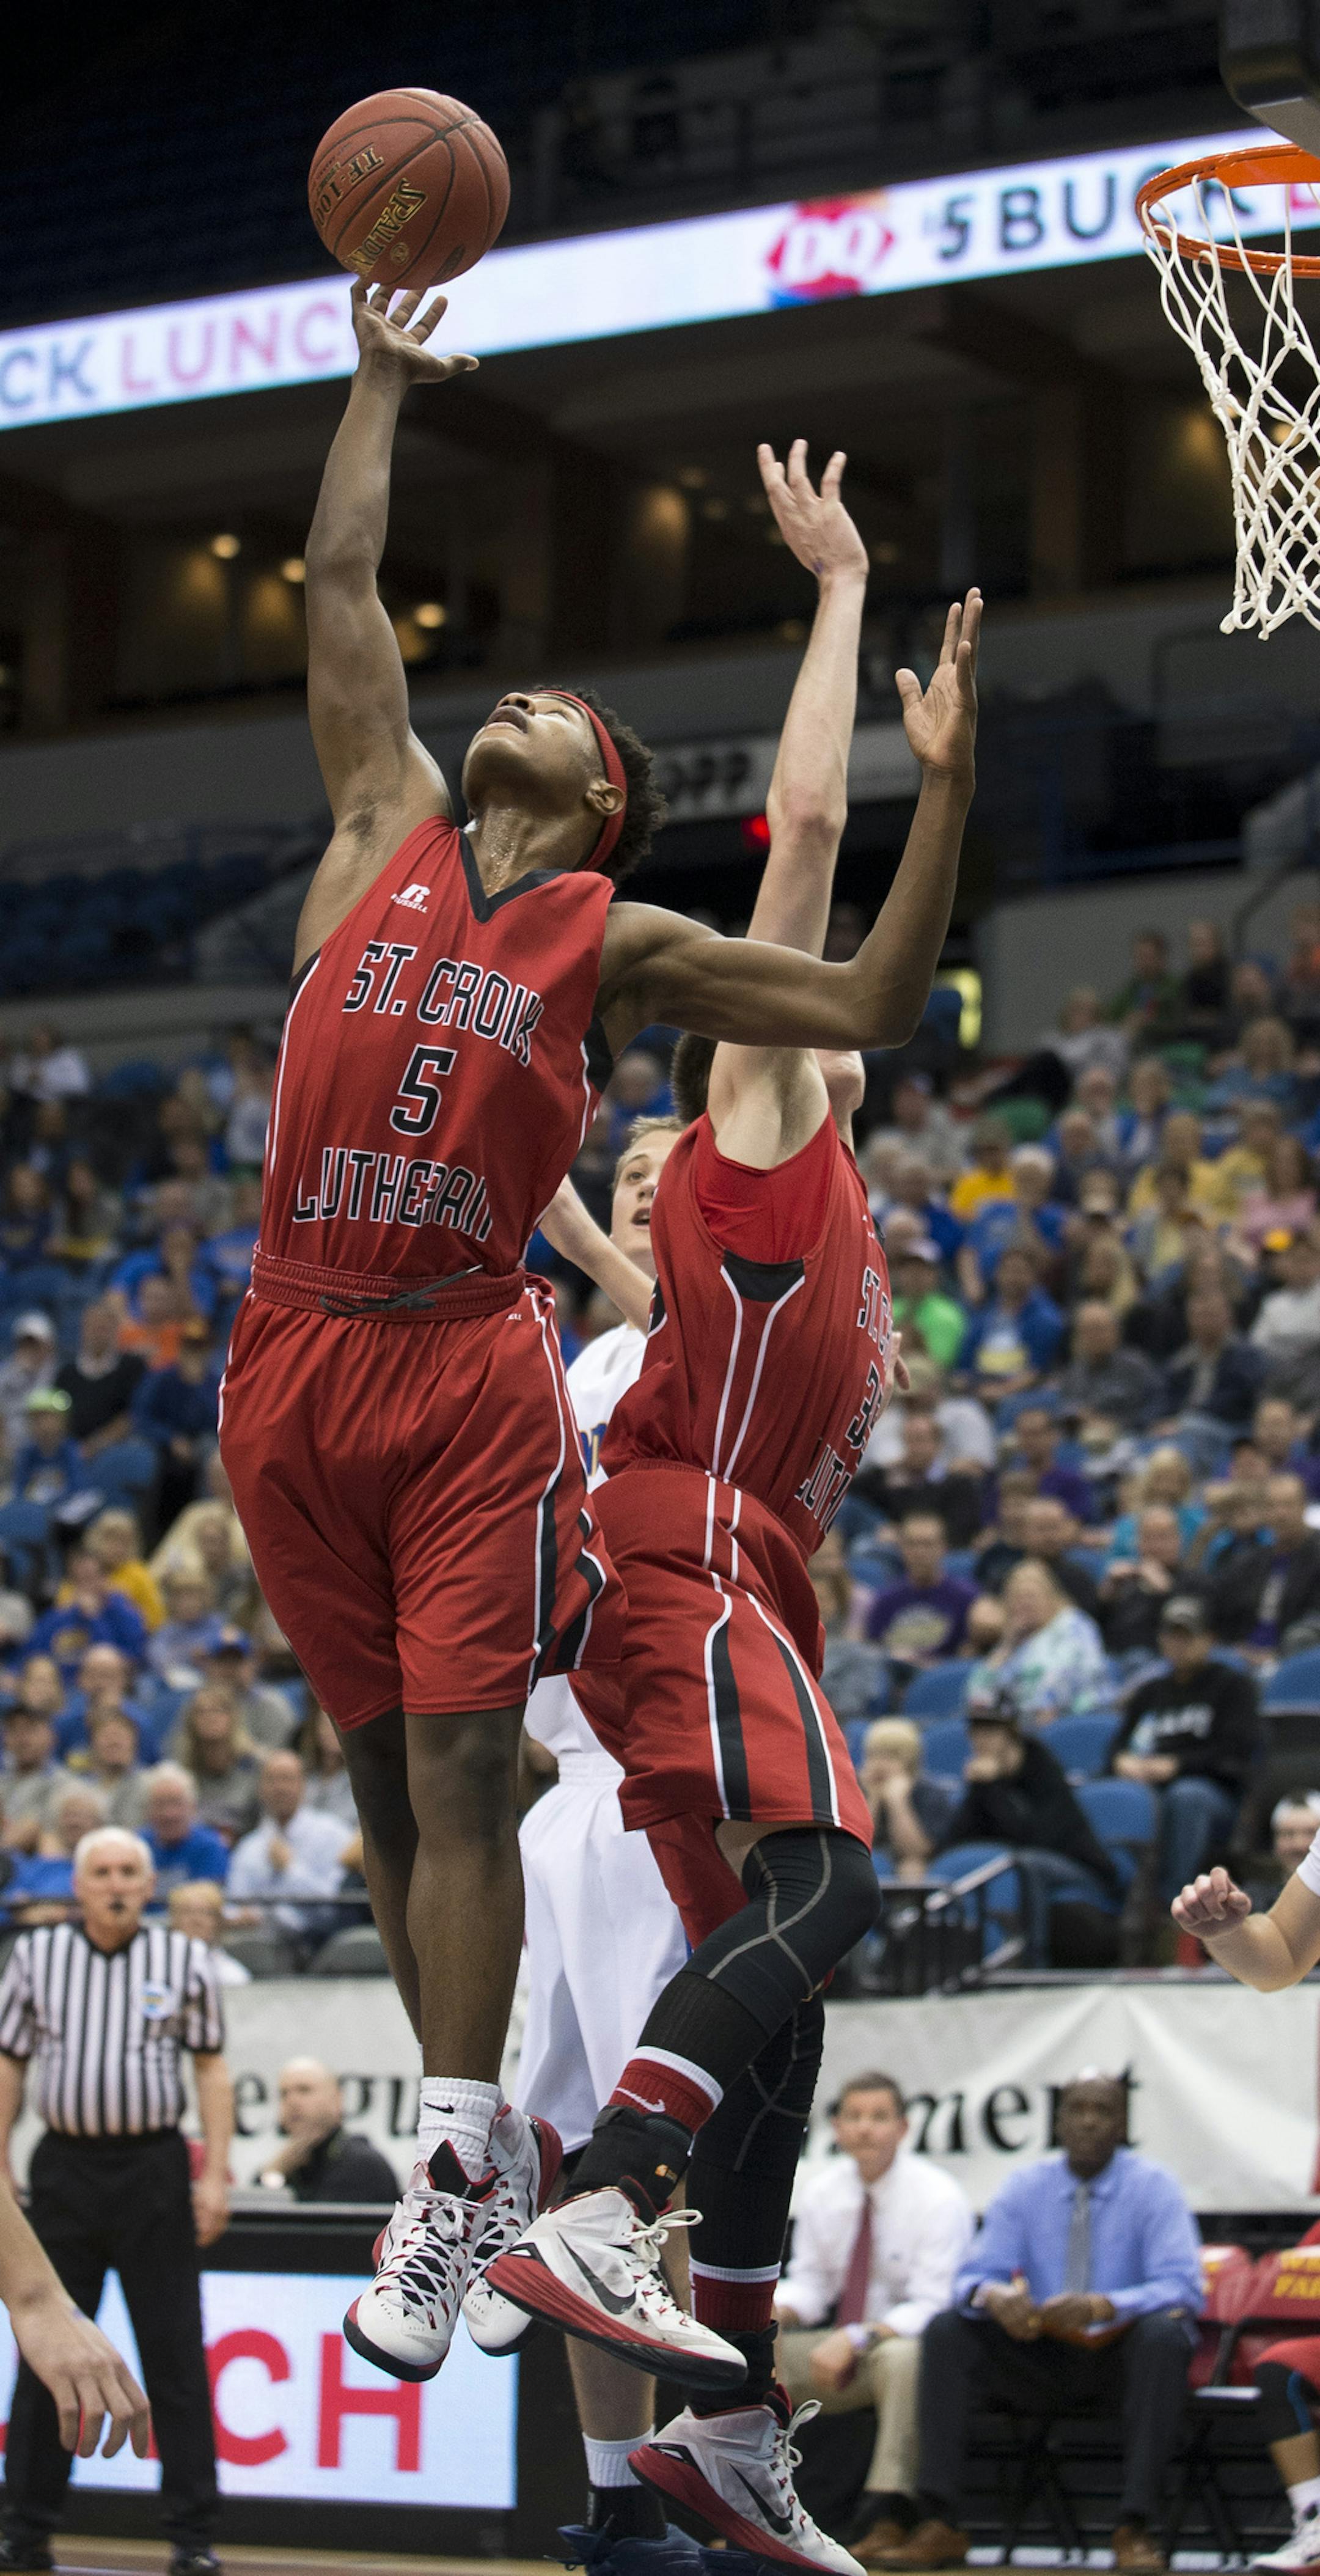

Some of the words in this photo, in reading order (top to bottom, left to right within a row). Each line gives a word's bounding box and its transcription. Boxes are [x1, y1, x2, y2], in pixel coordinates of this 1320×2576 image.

[120, 302, 360, 394] LUNC
[341, 939, 419, 1017] ST.
[416, 956, 545, 1068] CROIX
[389, 1043, 458, 1137] 5
